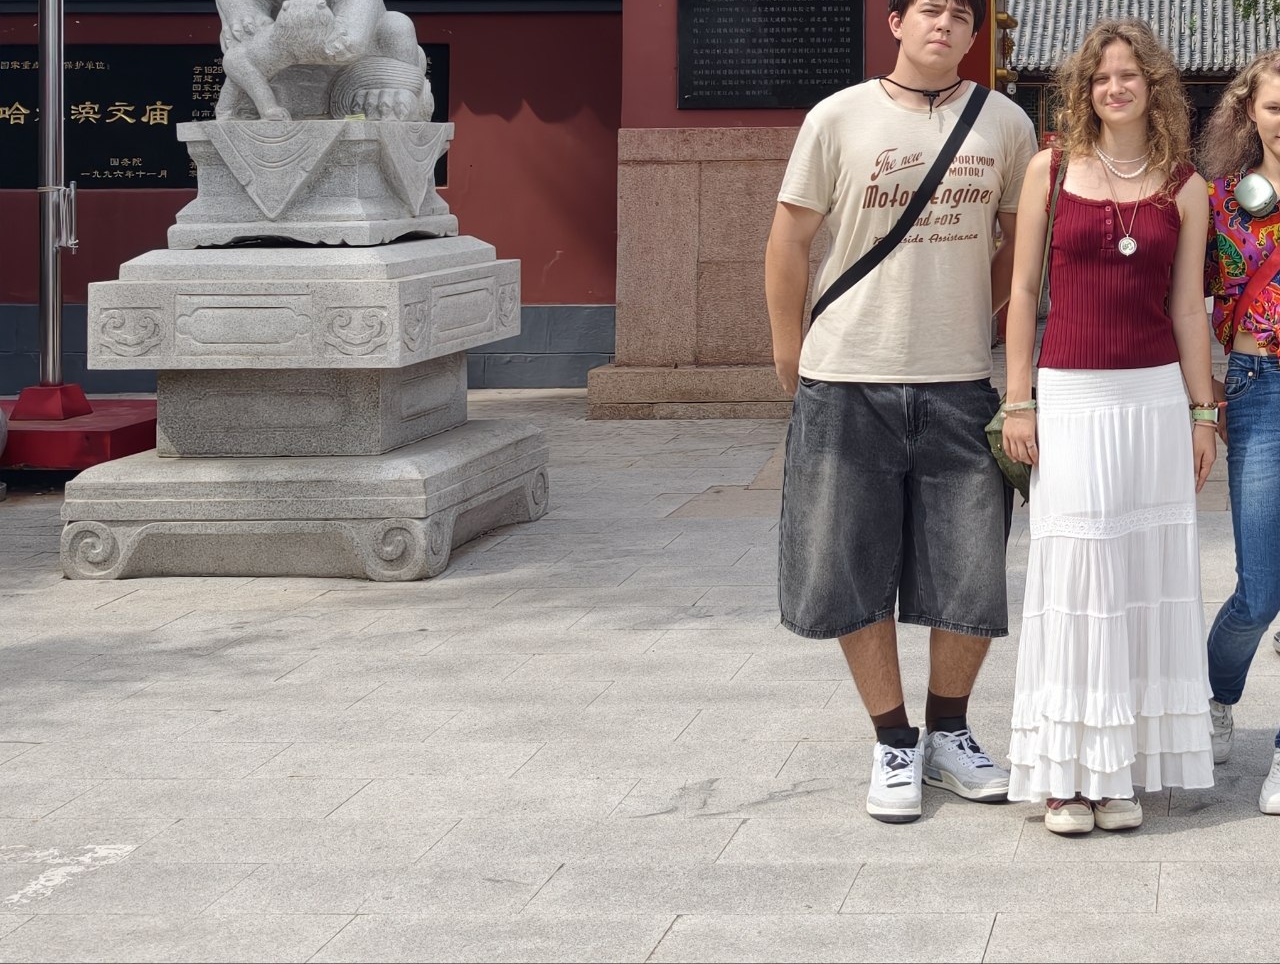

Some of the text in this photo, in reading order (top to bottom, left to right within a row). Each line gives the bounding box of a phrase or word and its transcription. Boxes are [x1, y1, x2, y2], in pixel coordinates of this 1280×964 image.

[0, 101, 173, 125] 哈滨文庙
[110, 157, 143, 166] 国务院
[870, 147, 923, 182] The new
[80, 170, 168, 179] 一九九六年十一月
[948, 166, 985, 178] MOTORS
